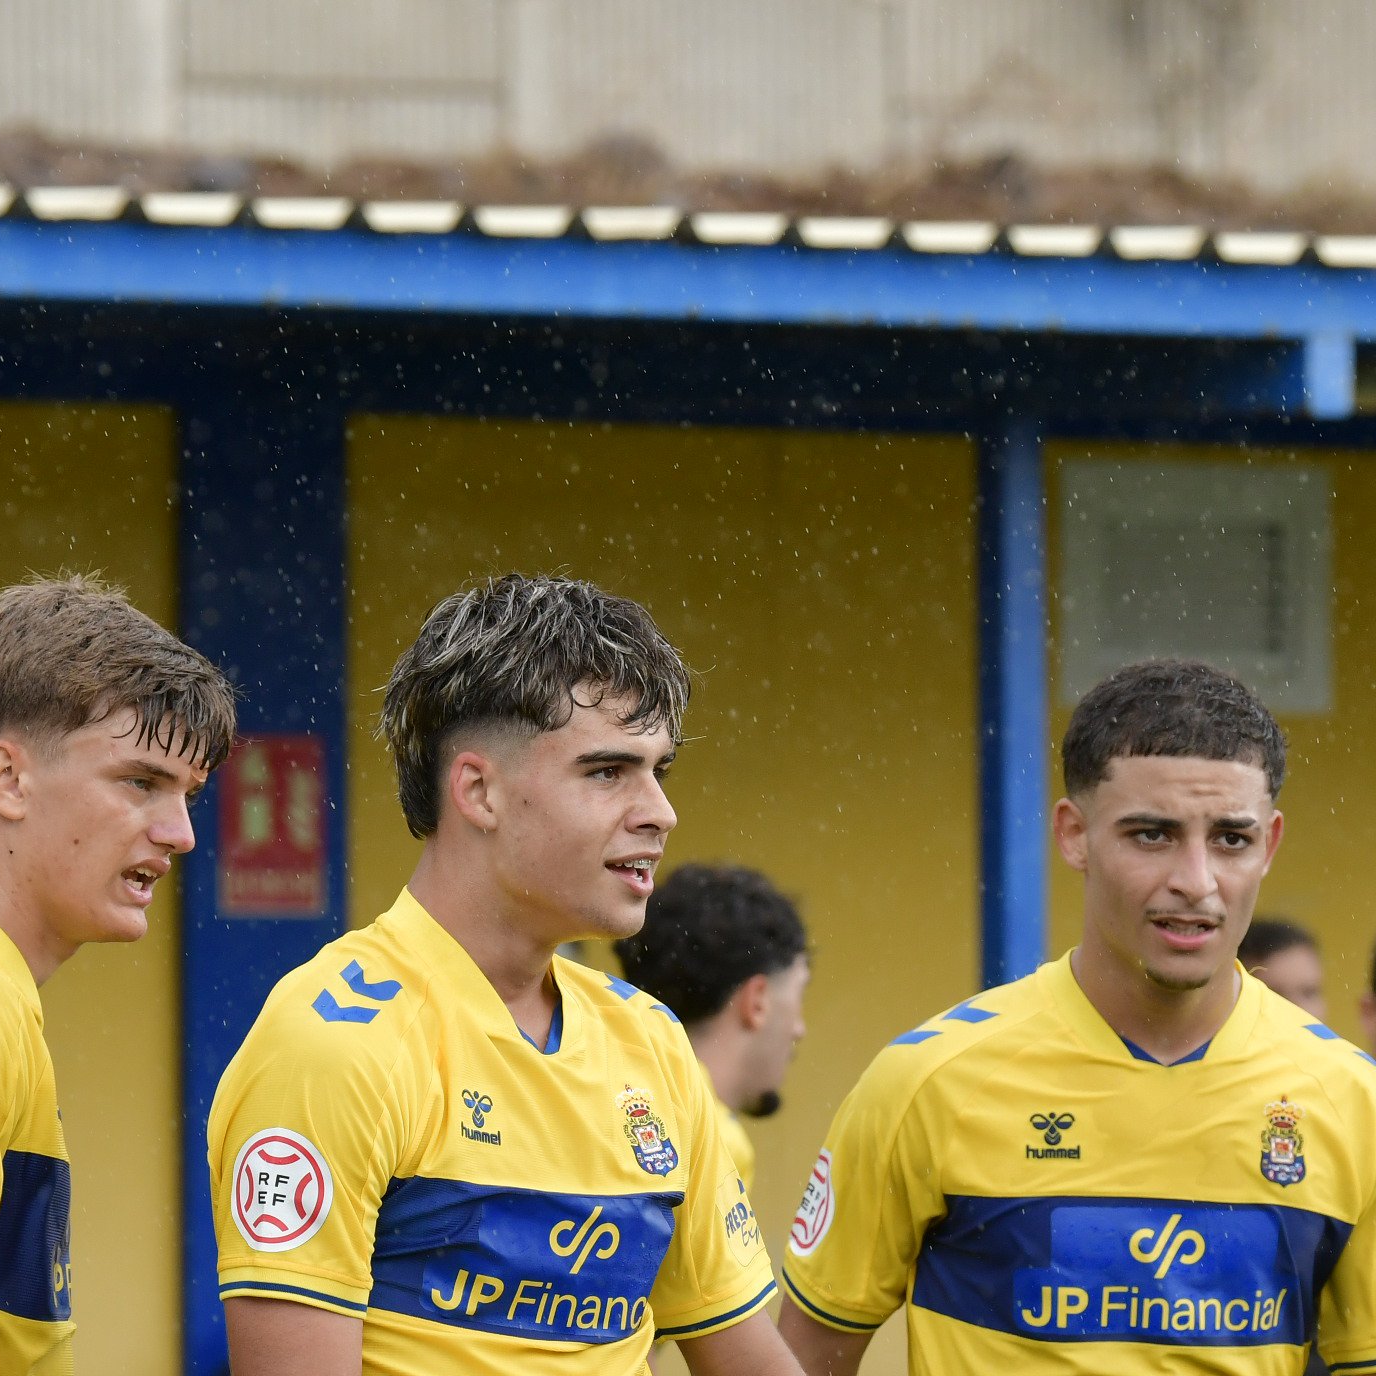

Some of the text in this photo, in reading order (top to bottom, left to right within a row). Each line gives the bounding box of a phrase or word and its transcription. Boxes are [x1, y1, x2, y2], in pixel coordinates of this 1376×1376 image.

[460, 1121, 501, 1146] hummel
[1025, 1145, 1081, 1160] hummel
[431, 1269, 505, 1317] JP
[1021, 1286, 1288, 1332] JP Financial
